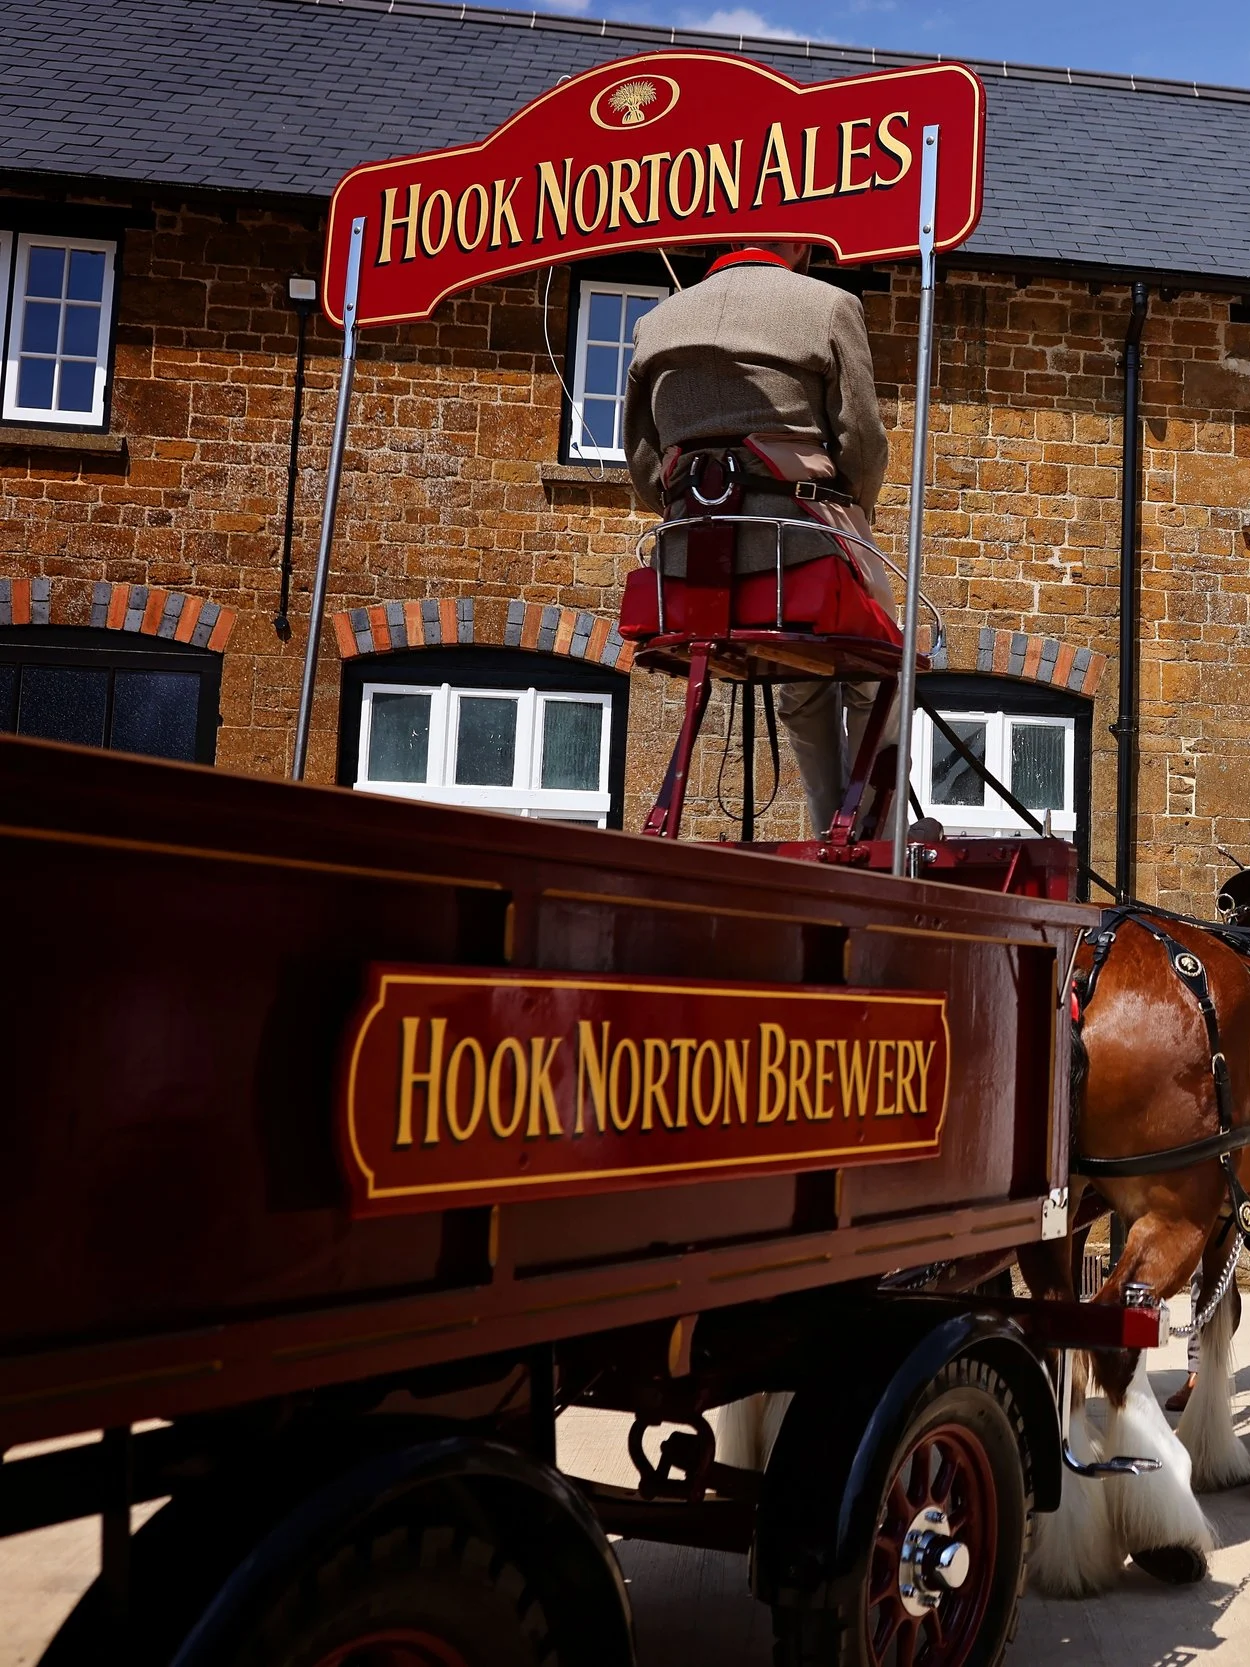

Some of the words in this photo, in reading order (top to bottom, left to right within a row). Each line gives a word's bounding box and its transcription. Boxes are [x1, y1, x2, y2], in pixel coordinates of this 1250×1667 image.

[377, 175, 524, 265] HOOK
[534, 138, 744, 241] NORTON
[753, 110, 913, 206] ALES
[396, 1017, 564, 1145] HOOK
[574, 1020, 751, 1134] NORTON
[757, 1022, 937, 1124] BREWERY
